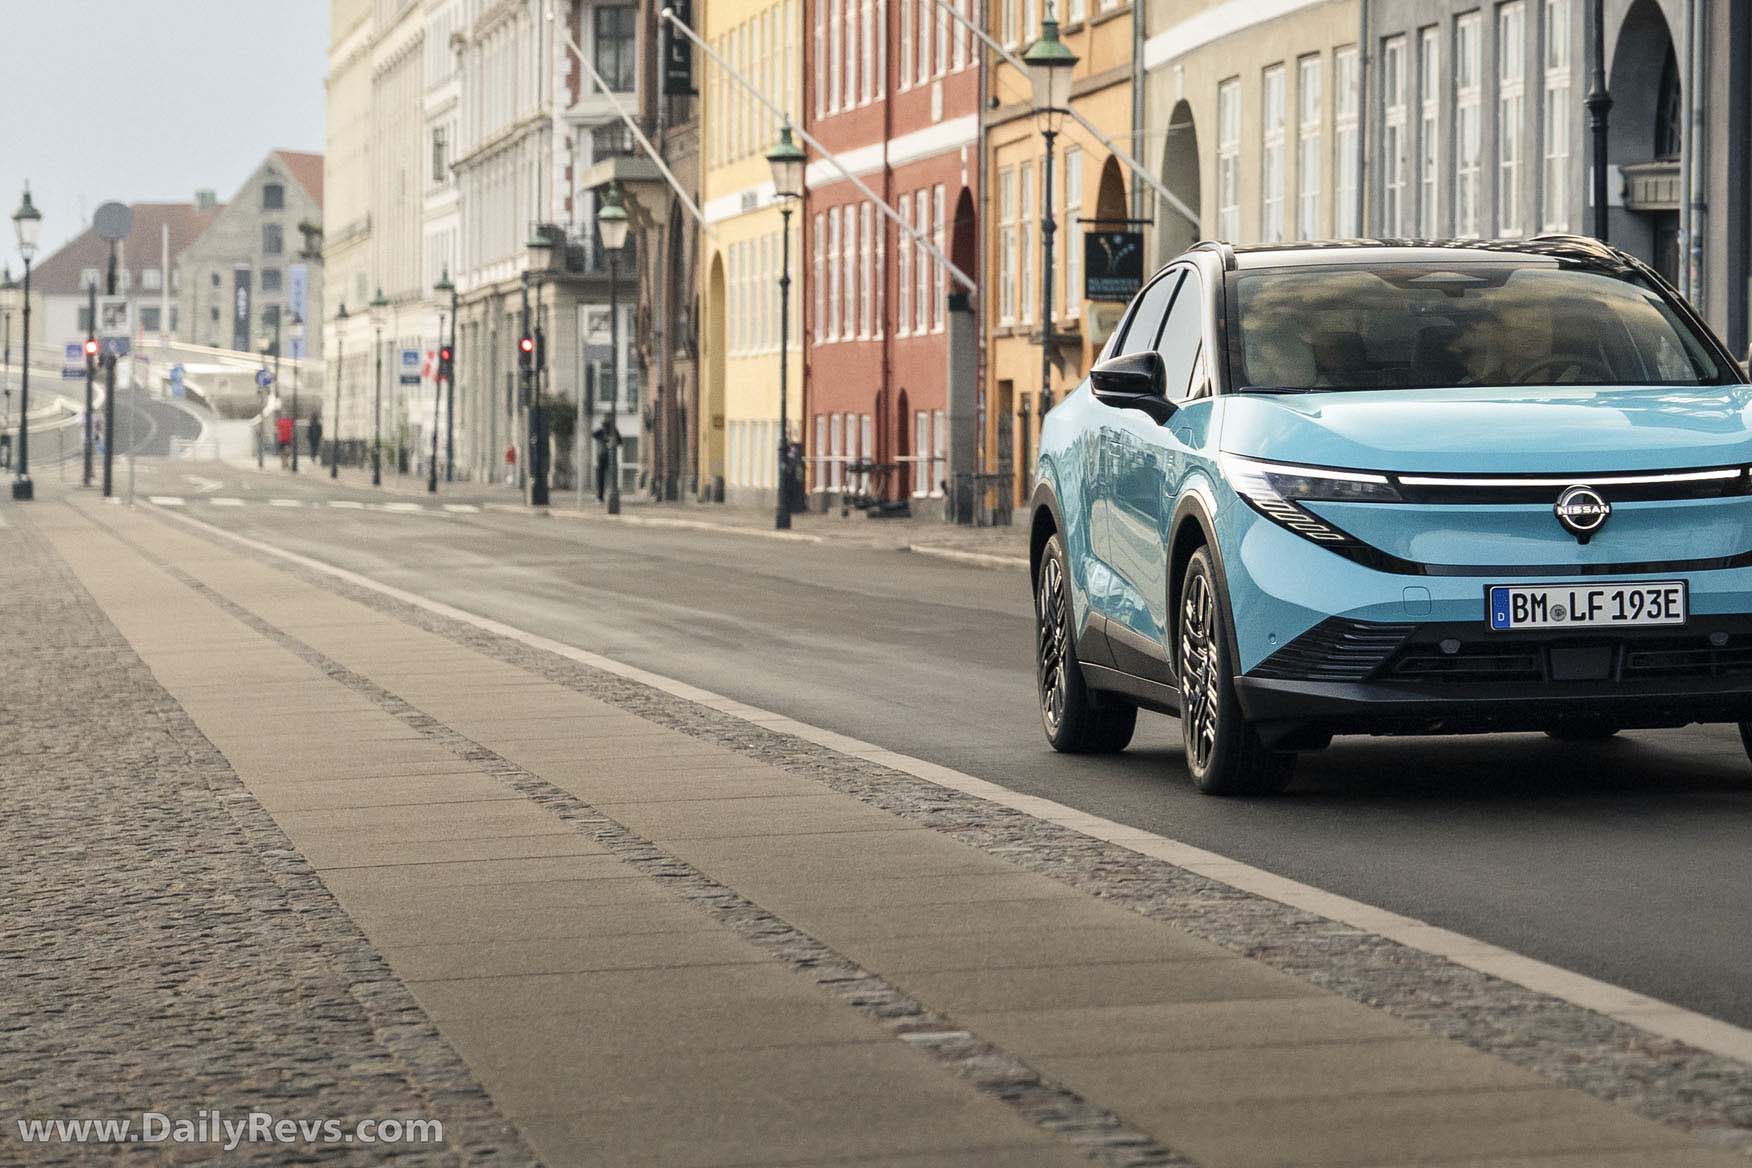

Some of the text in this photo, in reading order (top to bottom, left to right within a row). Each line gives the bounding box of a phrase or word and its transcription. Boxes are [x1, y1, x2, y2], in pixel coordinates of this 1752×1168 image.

[1557, 505, 1610, 515] NISSAN
[1512, 588, 1681, 623] BM LF 193E
[1497, 612, 1505, 621] D
